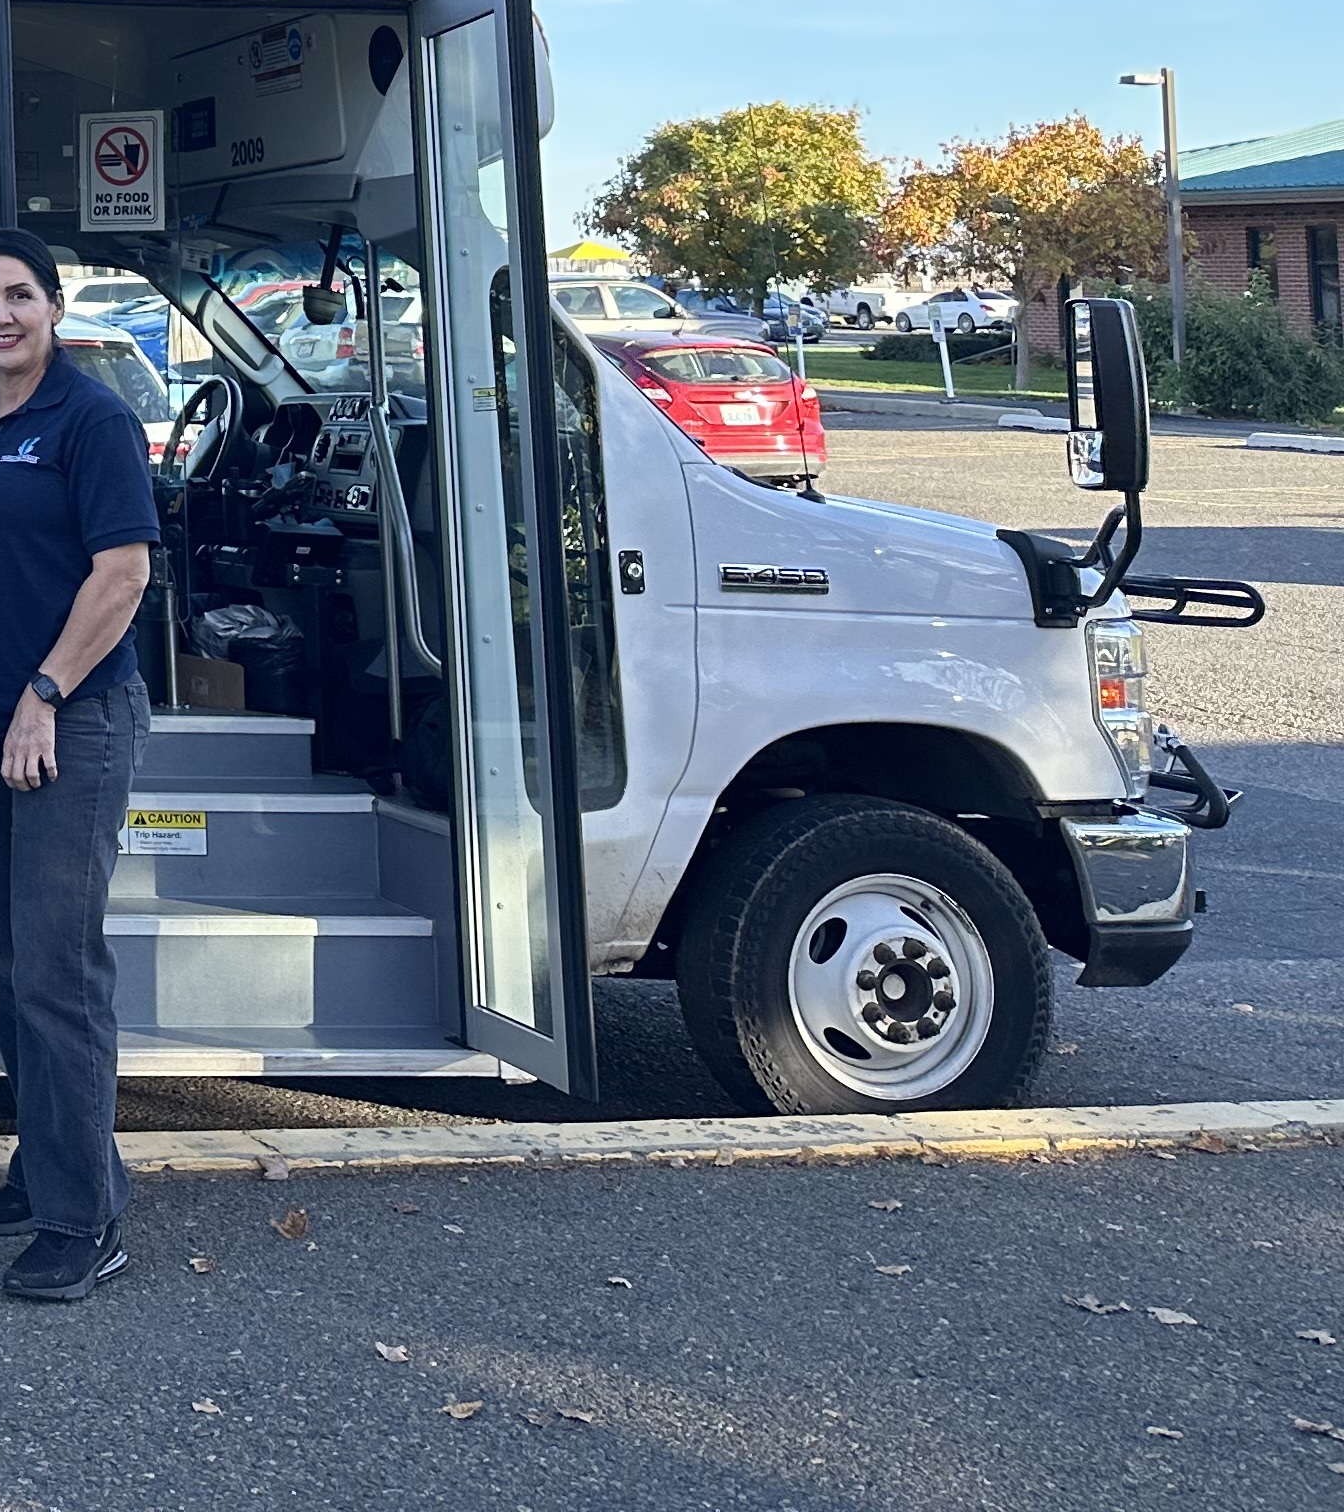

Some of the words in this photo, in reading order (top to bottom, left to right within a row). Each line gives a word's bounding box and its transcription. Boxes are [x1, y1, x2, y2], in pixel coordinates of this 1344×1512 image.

[231, 136, 265, 167] 2009
[95, 193, 113, 204] NO
[116, 192, 150, 203] FOOD
[93, 206, 111, 216] OR
[113, 205, 152, 216] DRINK
[148, 813, 201, 824] CAUTION
[135, 831, 150, 839] Trip
